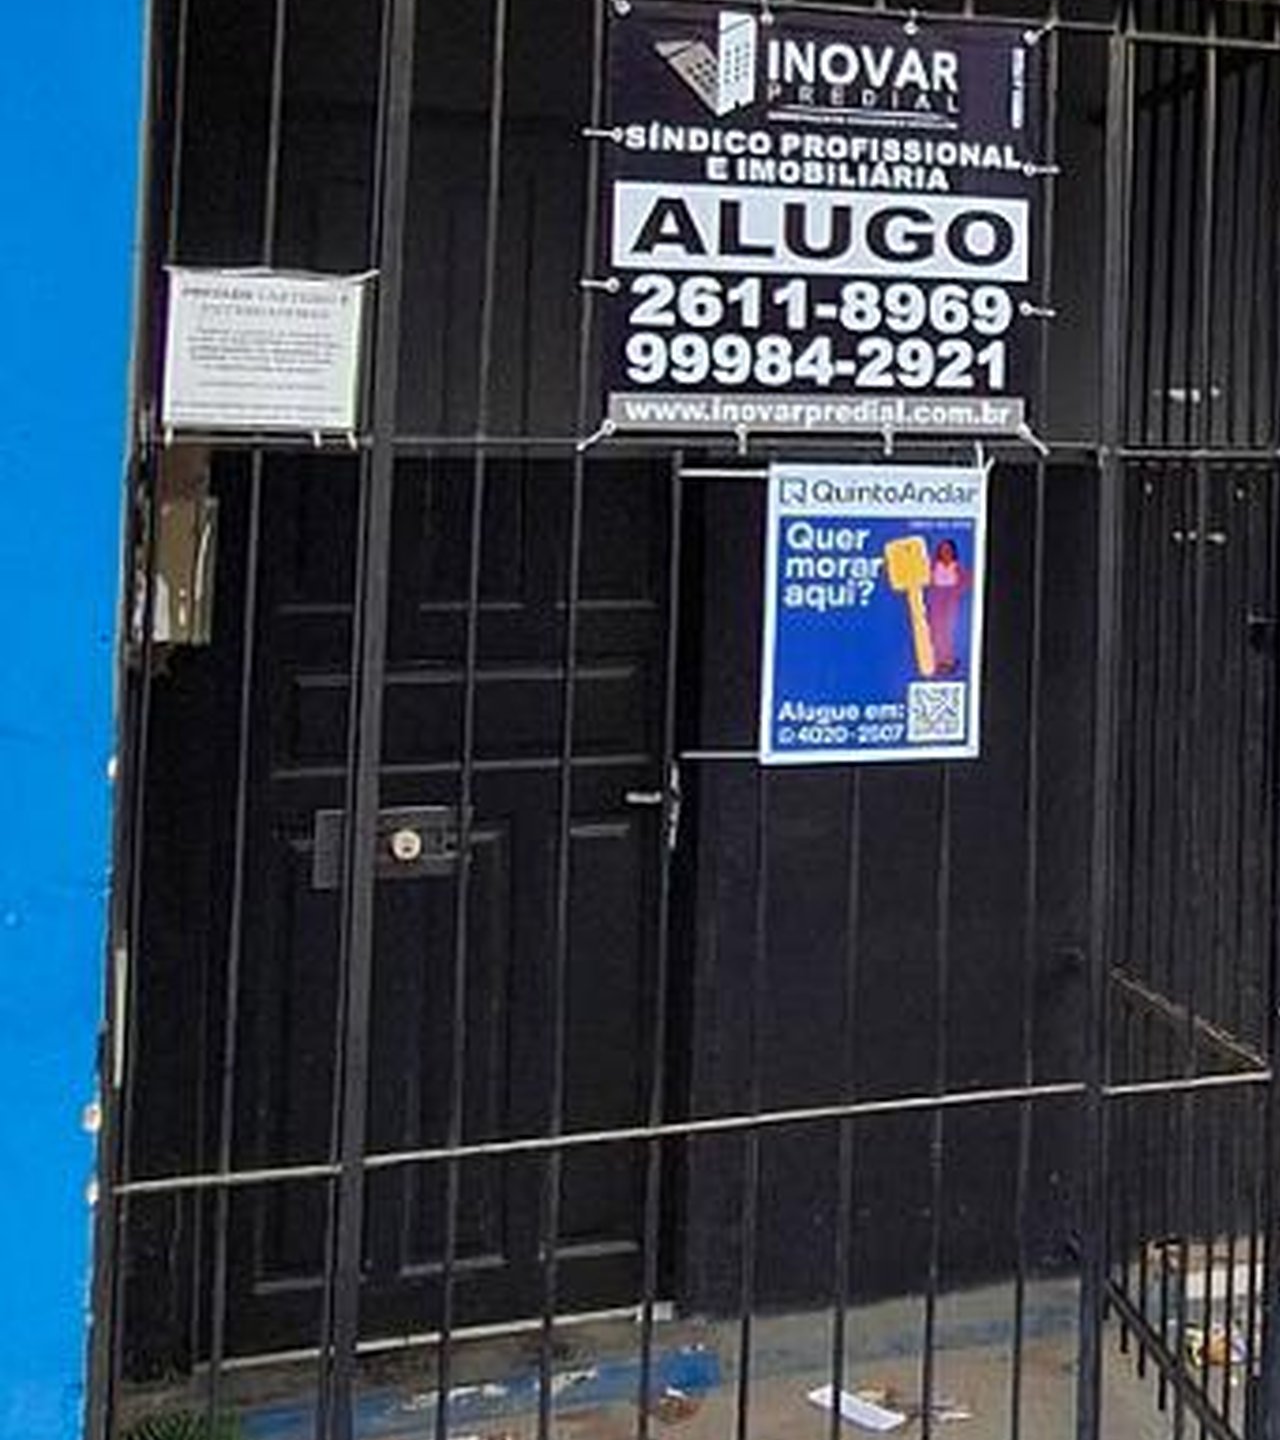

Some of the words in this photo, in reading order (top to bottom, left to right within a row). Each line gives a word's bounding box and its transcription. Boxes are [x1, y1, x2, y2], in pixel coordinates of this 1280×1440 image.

[768, 39, 959, 92] INOVAR
[767, 83, 960, 113] PREDIAL
[625, 121, 772, 155] SÍNDICO
[780, 133, 1021, 170] PROFISSIONAL
[707, 157, 728, 181] E
[738, 156, 949, 191] IMOBILIÁRIA
[631, 197, 1014, 267] ALUGO
[629, 274, 1013, 335] 2611-8969
[625, 333, 1007, 389] 99984-2921
[625, 398, 1011, 428] www.inovarpredial.com.br
[811, 479, 978, 504] QuintoAndar
[786, 521, 870, 552] Quer
[785, 555, 884, 579] morar
[783, 580, 876, 611] aqui?
[778, 701, 860, 725] Alugue
